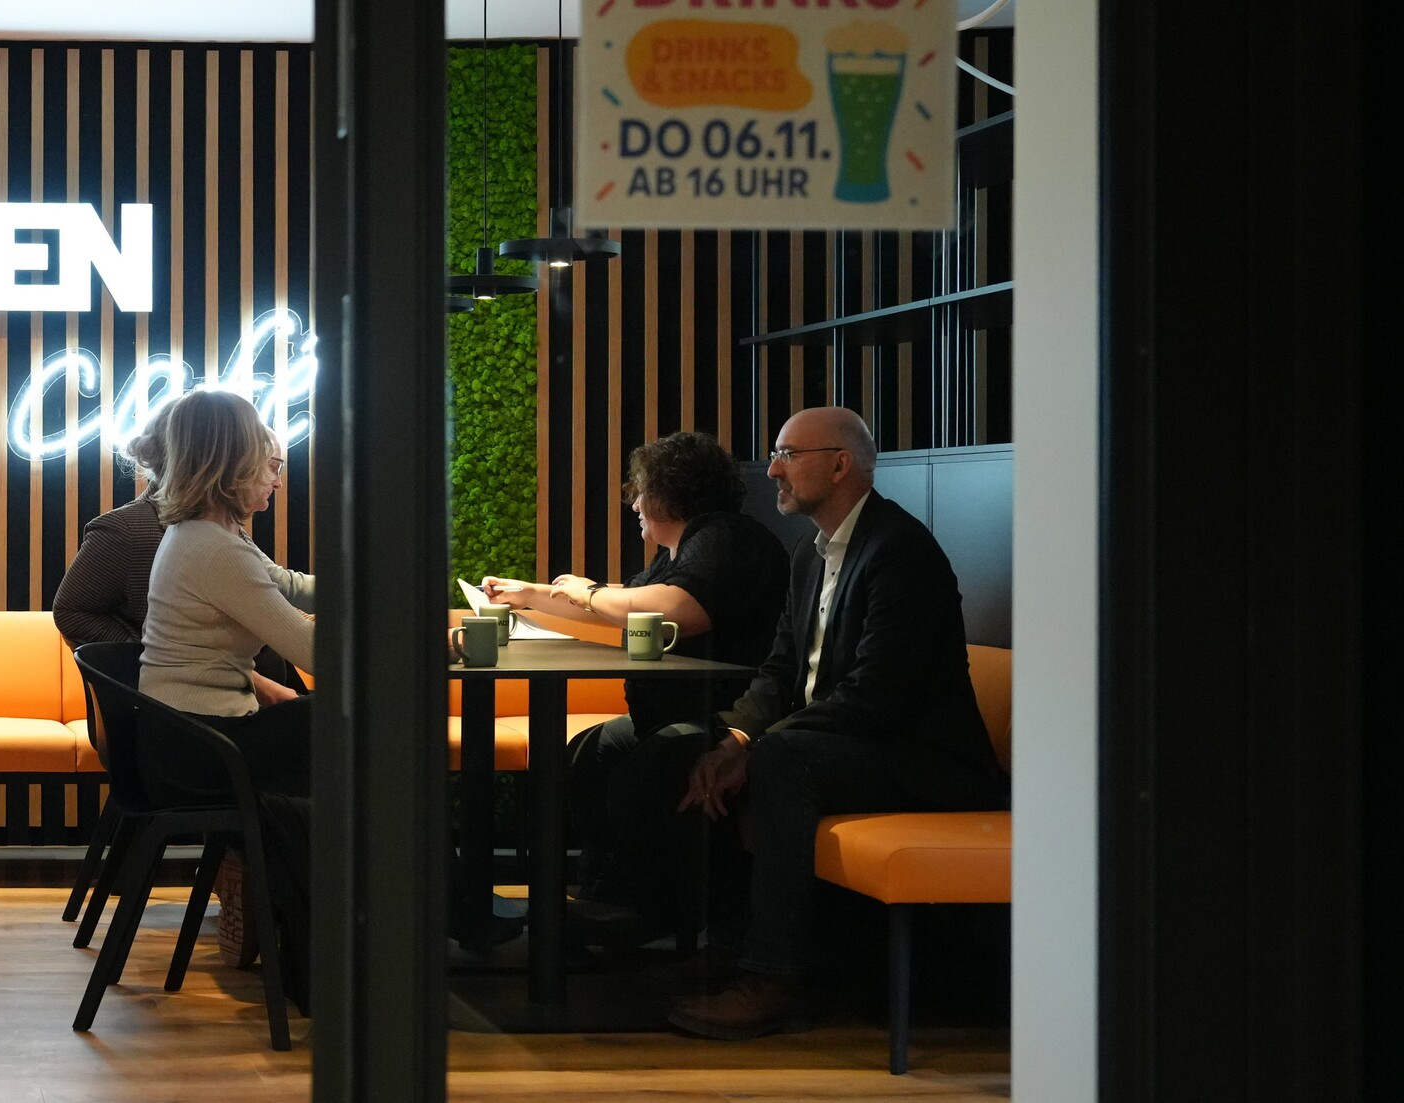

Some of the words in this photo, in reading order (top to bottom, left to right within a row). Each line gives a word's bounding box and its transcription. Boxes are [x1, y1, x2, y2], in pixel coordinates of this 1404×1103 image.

[651, 37, 771, 63] DRINKS
[641, 68, 662, 94] &
[669, 68, 788, 94] SNACKS
[619, 118, 692, 159] DO
[701, 118, 832, 160] 06.11.
[627, 166, 677, 197] AB
[687, 166, 726, 197] 16
[734, 167, 810, 198] UHR
